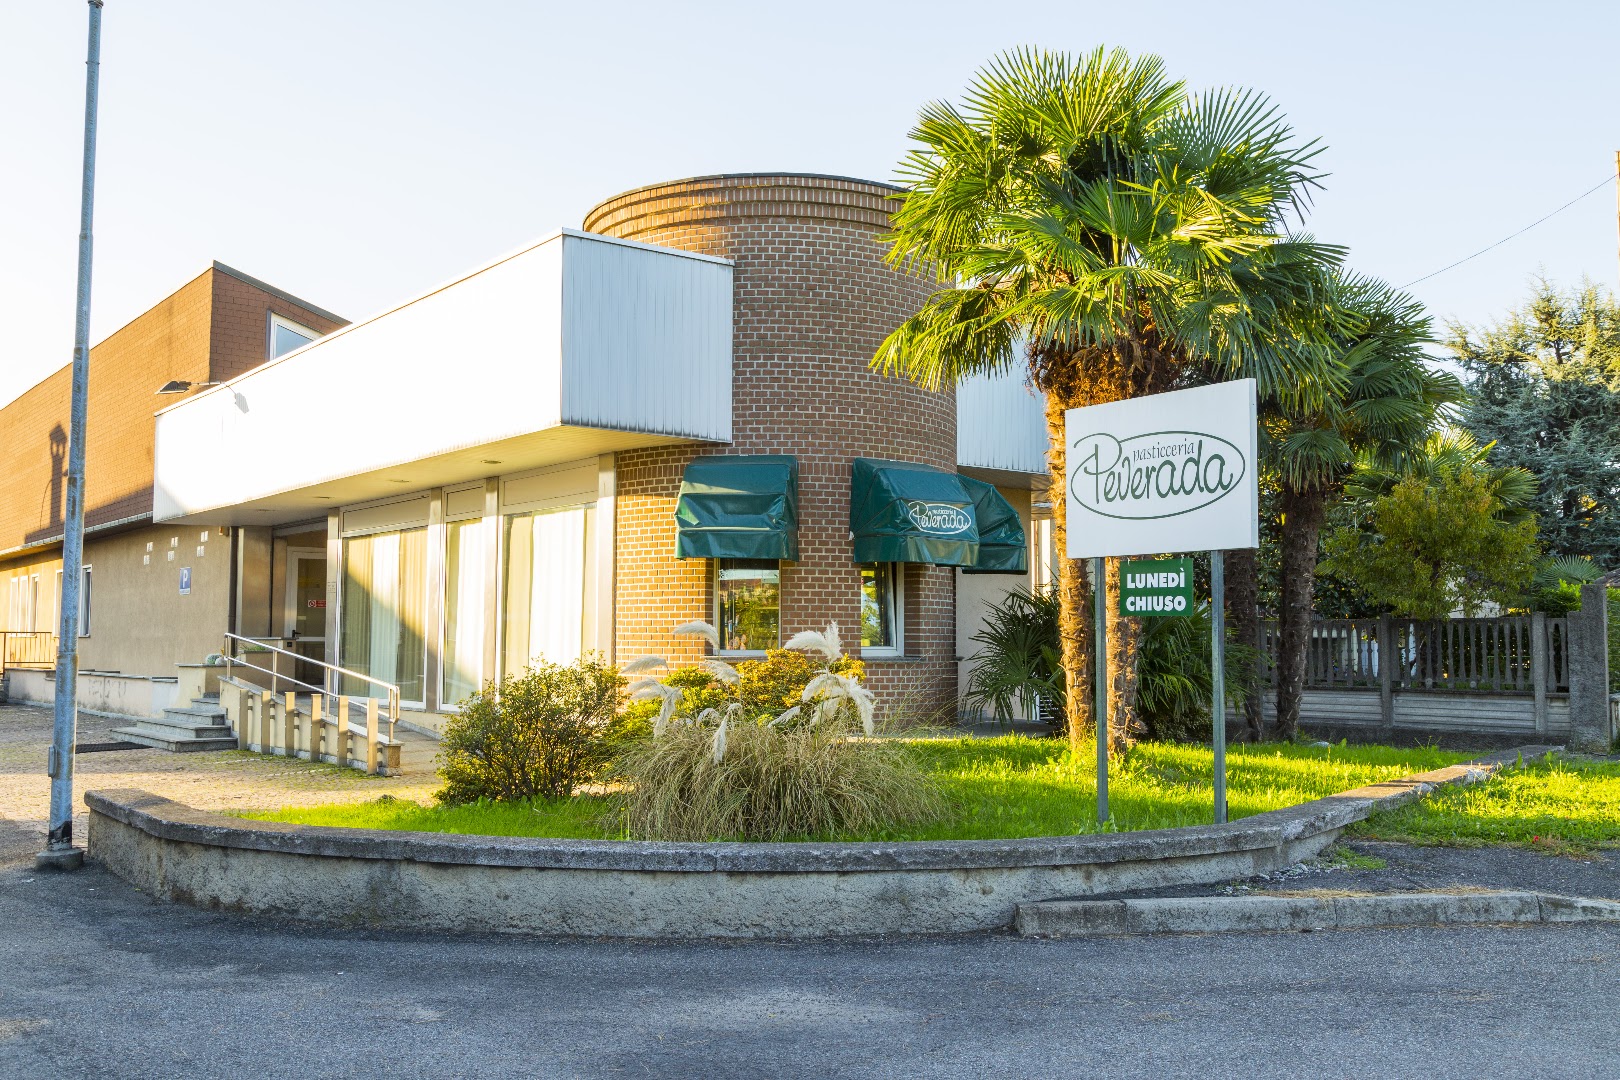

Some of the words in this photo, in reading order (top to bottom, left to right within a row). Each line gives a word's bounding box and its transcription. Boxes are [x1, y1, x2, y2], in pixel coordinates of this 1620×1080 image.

[1133, 437, 1195, 466] pasticceria
[1074, 432, 1234, 505] Peverada
[908, 501, 969, 529] Peverada
[182, 569, 189, 588] P
[1126, 567, 1186, 589] LUNEDÌ
[1125, 595, 1187, 612] CHIUSO
